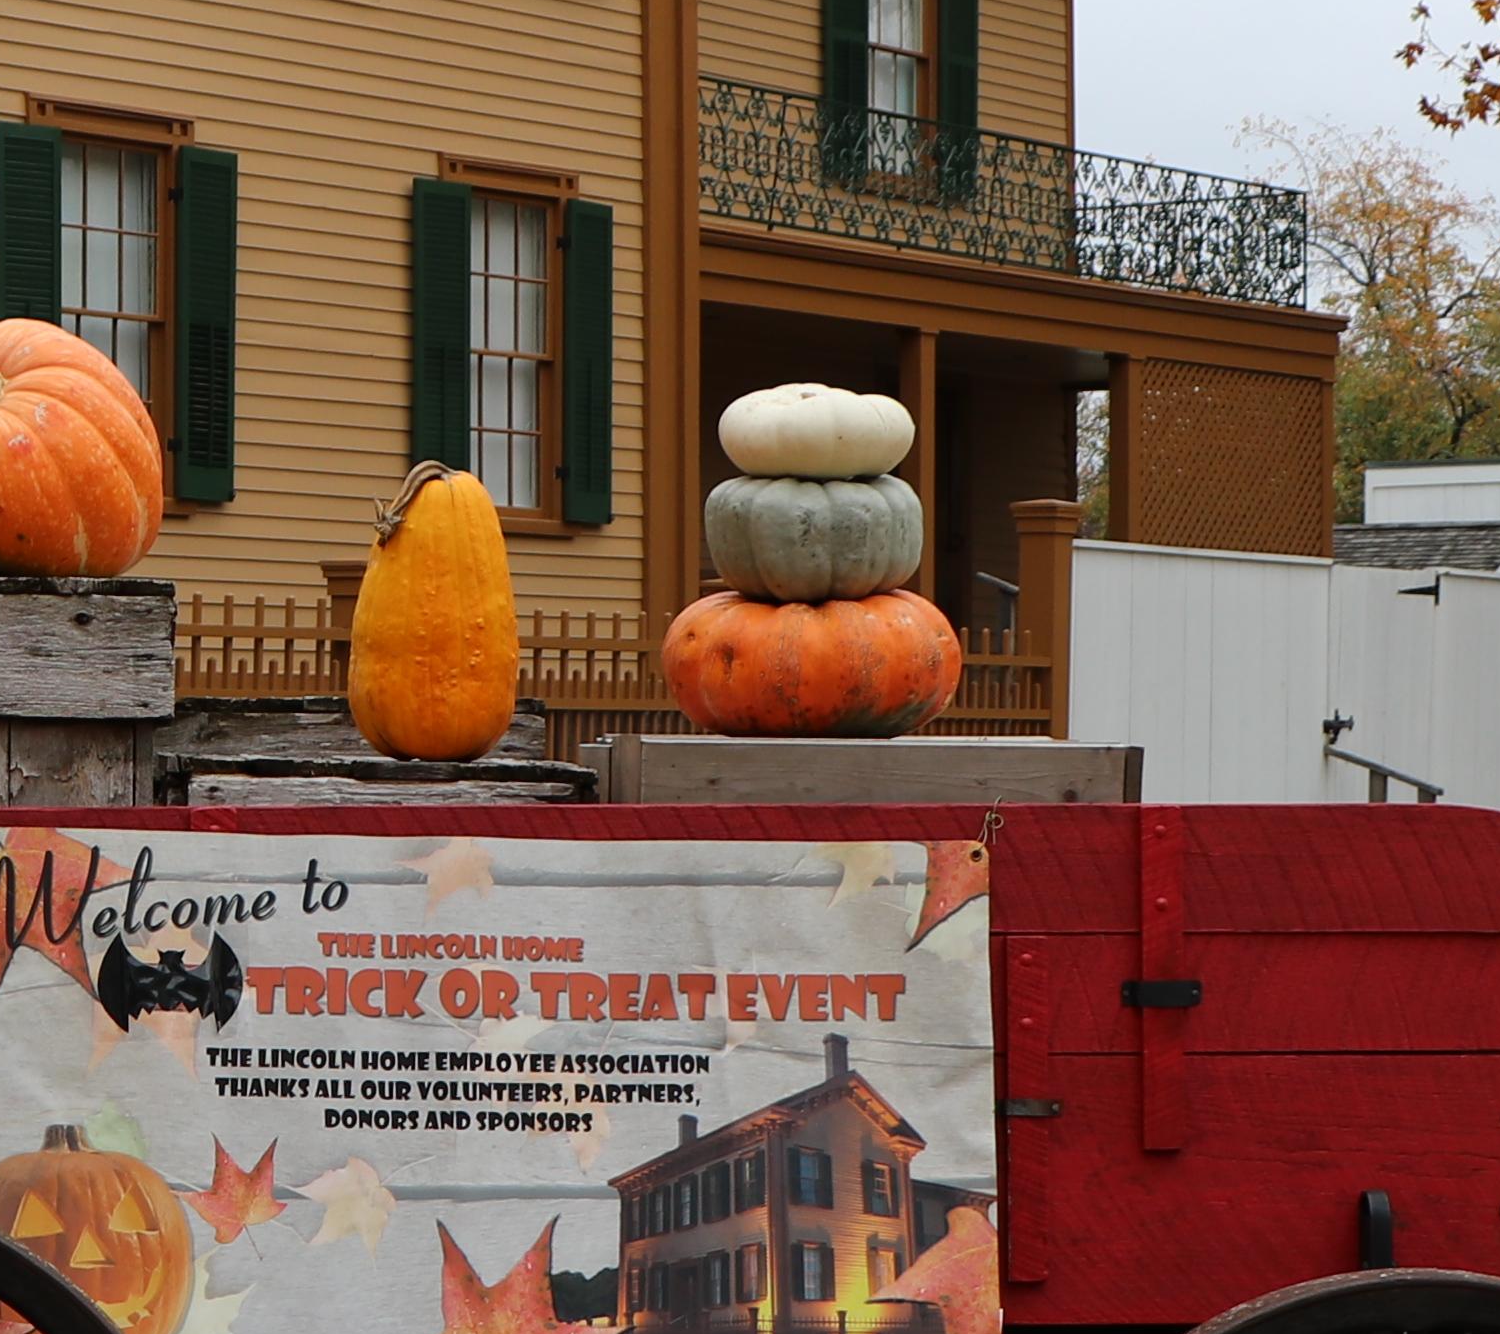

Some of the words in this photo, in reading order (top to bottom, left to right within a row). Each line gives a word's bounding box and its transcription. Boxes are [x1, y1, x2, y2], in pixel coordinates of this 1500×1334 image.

[301, 858, 350, 914] to
[317, 932, 375, 958] THE
[381, 934, 497, 960] LINCOLN
[502, 936, 584, 963] HOME
[246, 966, 428, 1019] TRICK
[438, 969, 520, 1021] OR
[530, 971, 716, 1023] TREAT
[726, 973, 906, 1022] EVENT
[206, 1047, 252, 1067] THE
[258, 1048, 355, 1070] LINCOLN
[361, 1051, 430, 1071] HOME
[435, 1052, 556, 1074] EMPLOYEE
[560, 1053, 710, 1075] ASSOCIATION
[215, 1077, 309, 1099] THANKS
[314, 1079, 356, 1100] ALL
[360, 1080, 411, 1101] OUR
[417, 1081, 569, 1106] VOLUNTEERS,
[574, 1083, 701, 1107] PARTNERS,
[324, 1109, 419, 1130] DONORS
[424, 1110, 471, 1131] AND
[476, 1111, 593, 1133] SPONSORS
